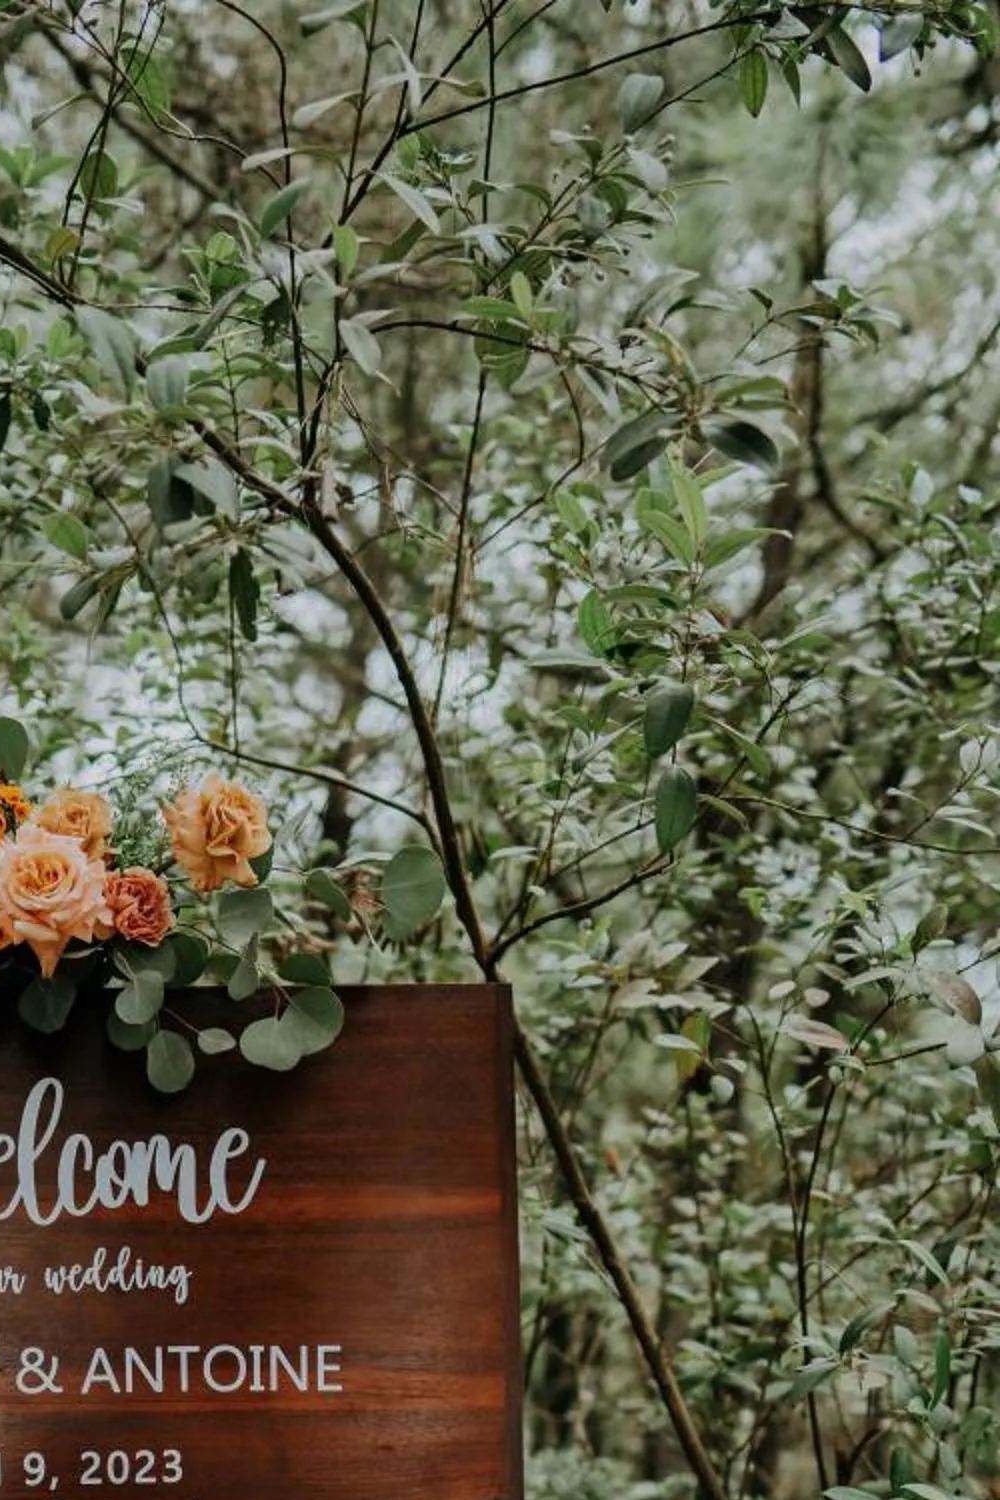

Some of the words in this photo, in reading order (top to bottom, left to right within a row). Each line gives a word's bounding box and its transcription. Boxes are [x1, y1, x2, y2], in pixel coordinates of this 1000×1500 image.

[45, 1247, 193, 1304] wedding
[15, 1346, 63, 1394] &
[81, 1344, 343, 1394] ANTOINE
[23, 1452, 59, 1490] 9,
[80, 1449, 184, 1485] 2023
